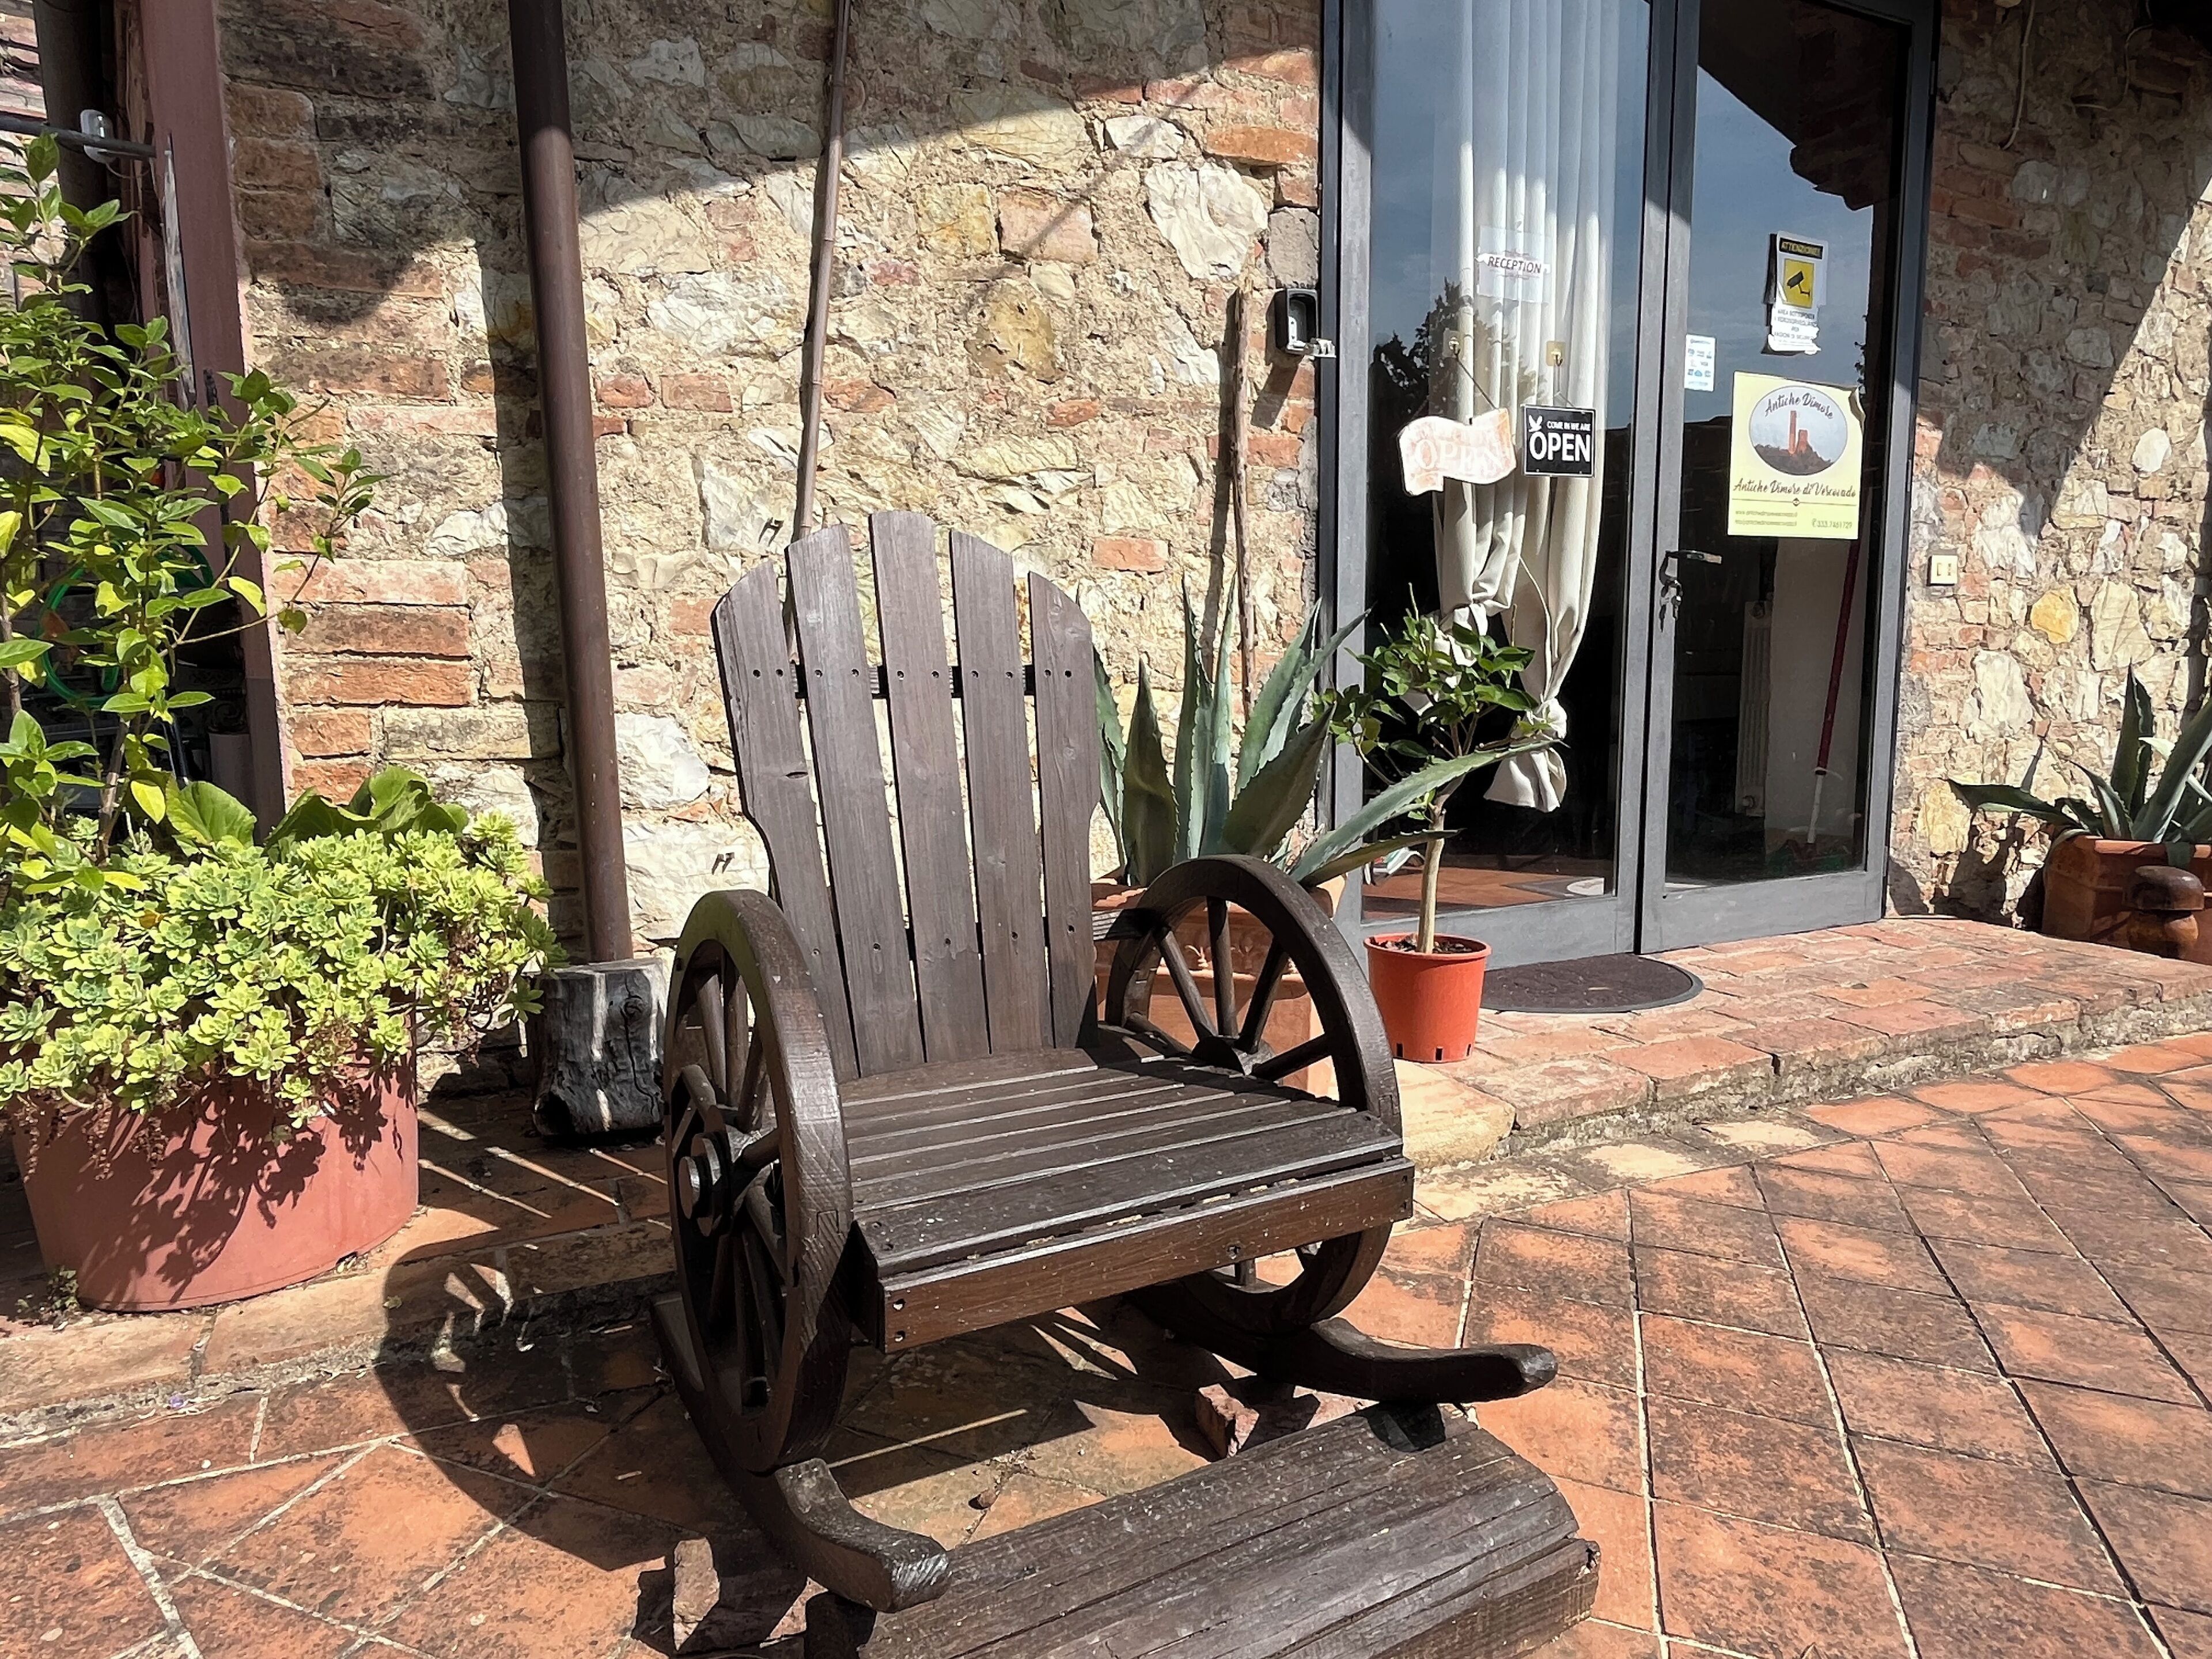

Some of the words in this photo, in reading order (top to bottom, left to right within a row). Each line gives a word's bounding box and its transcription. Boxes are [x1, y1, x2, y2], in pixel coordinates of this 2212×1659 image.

[1487, 256, 1541, 274] RECEPTION
[1764, 392, 1801, 417] Antiche
[1802, 392, 1833, 419] Dimore
[1547, 421, 1563, 430] COME
[1570, 423, 1580, 431] WE
[1580, 423, 1591, 431] ARE
[1414, 438, 1503, 474] OPEN
[1529, 431, 1591, 462] OPEN
[1733, 478, 1768, 493] Antiche
[1770, 480, 1801, 494] Dimore
